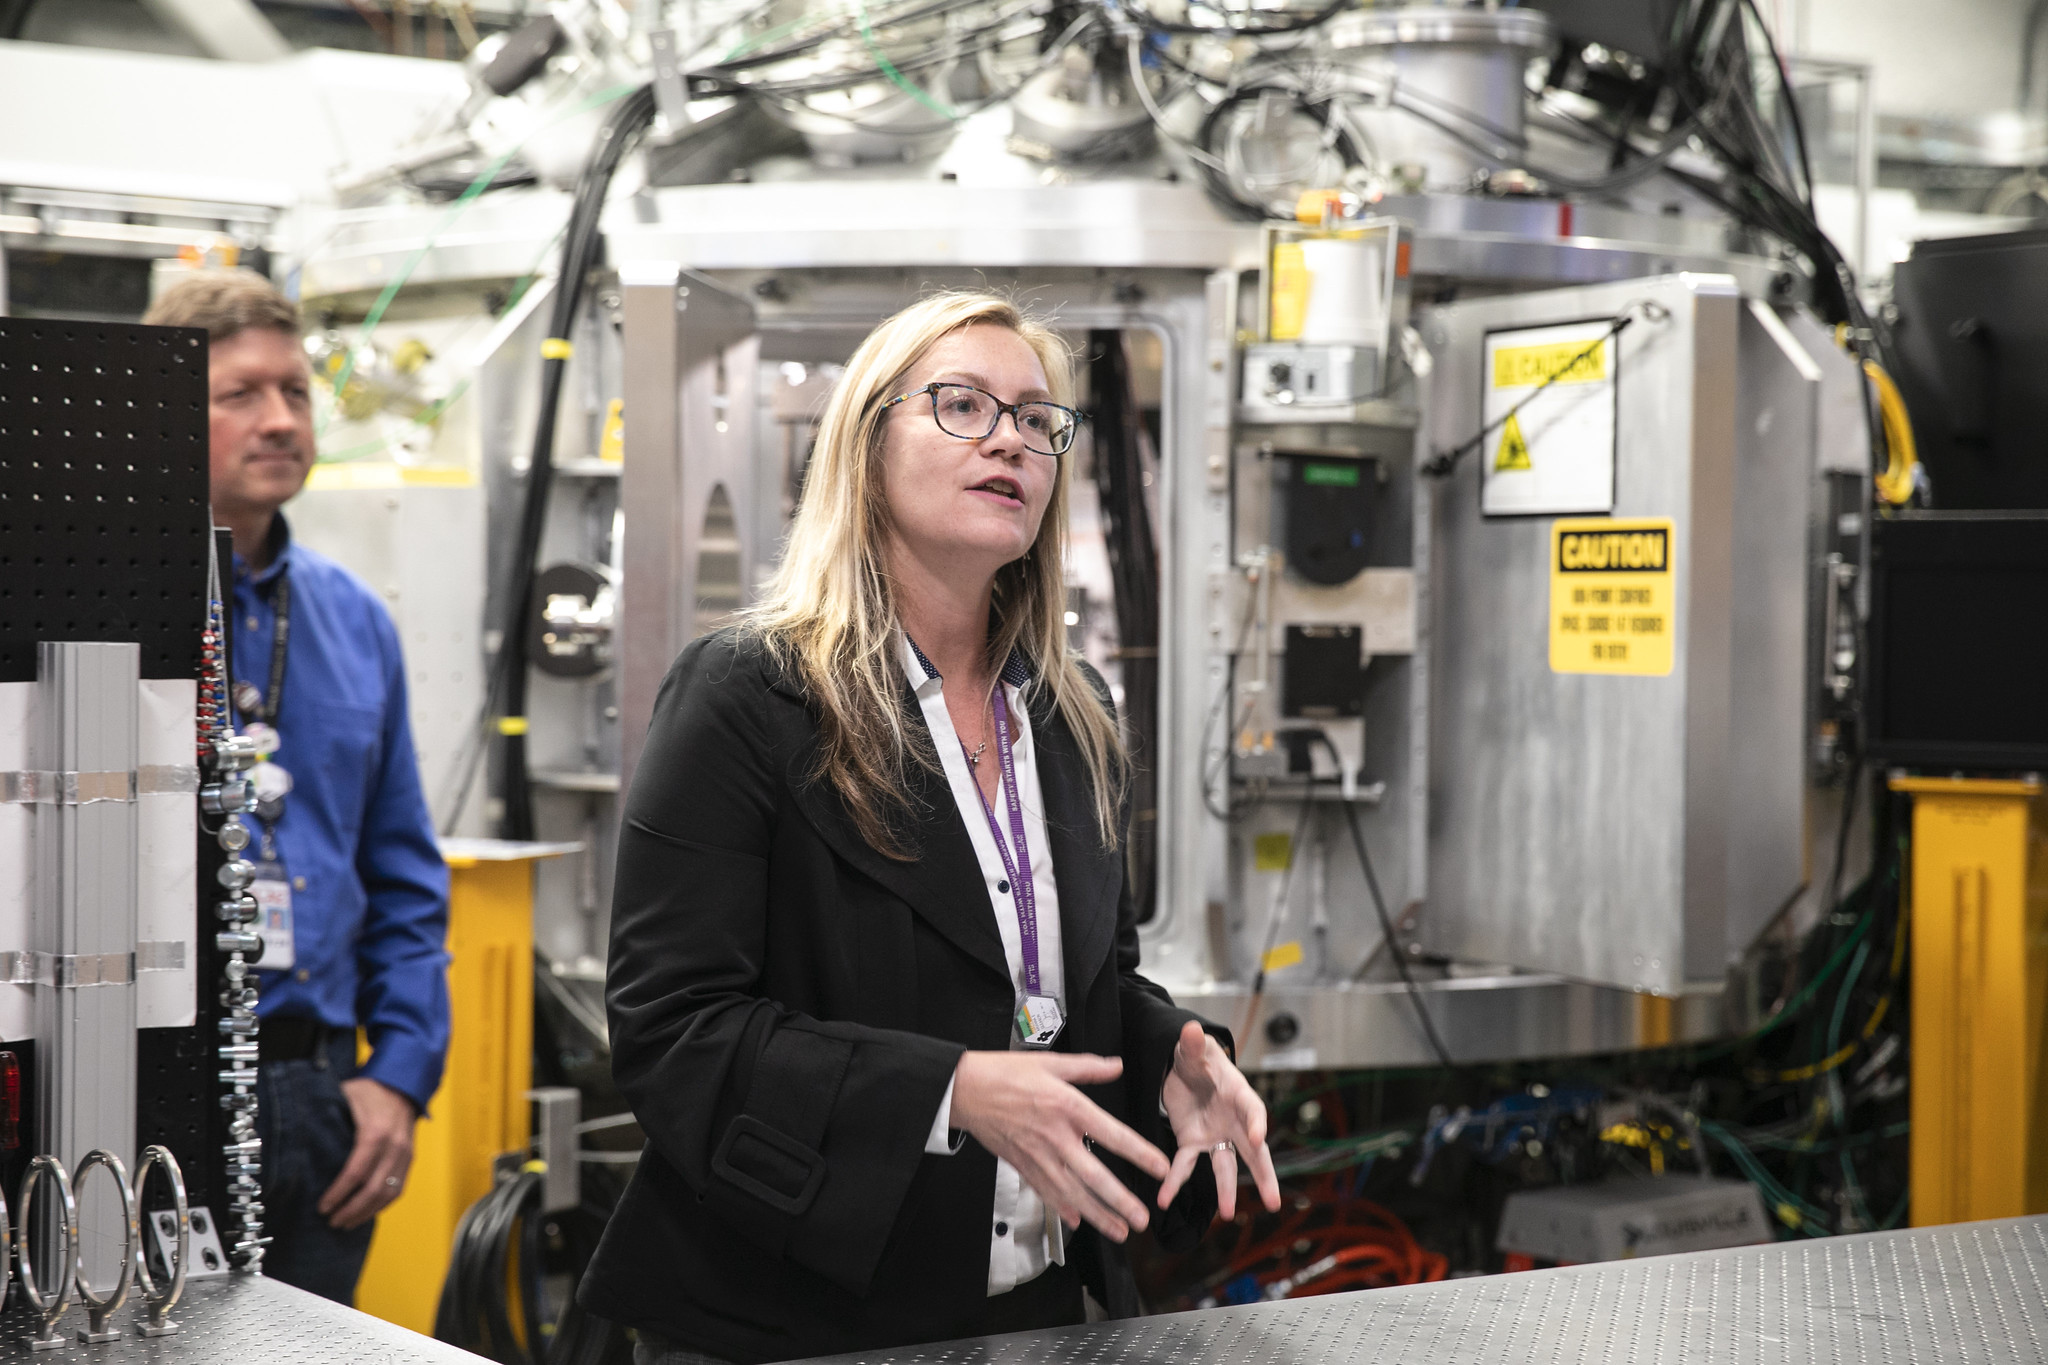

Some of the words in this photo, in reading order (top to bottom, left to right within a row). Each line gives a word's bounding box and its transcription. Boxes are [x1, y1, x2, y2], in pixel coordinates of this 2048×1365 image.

[1562, 532, 1665, 569] CAUTION
[999, 720, 1007, 734] YOU
[1000, 735, 1009, 753] WITH
[1003, 754, 1013, 783] STARTS
[1006, 783, 1018, 812] SAFETY
[999, 839, 1013, 866] SAFETY
[1008, 867, 1022, 897] STARTS
[1018, 896, 1026, 919] WITH
[1024, 881, 1033, 898] YOU
[1026, 898, 1035, 921] WITH
